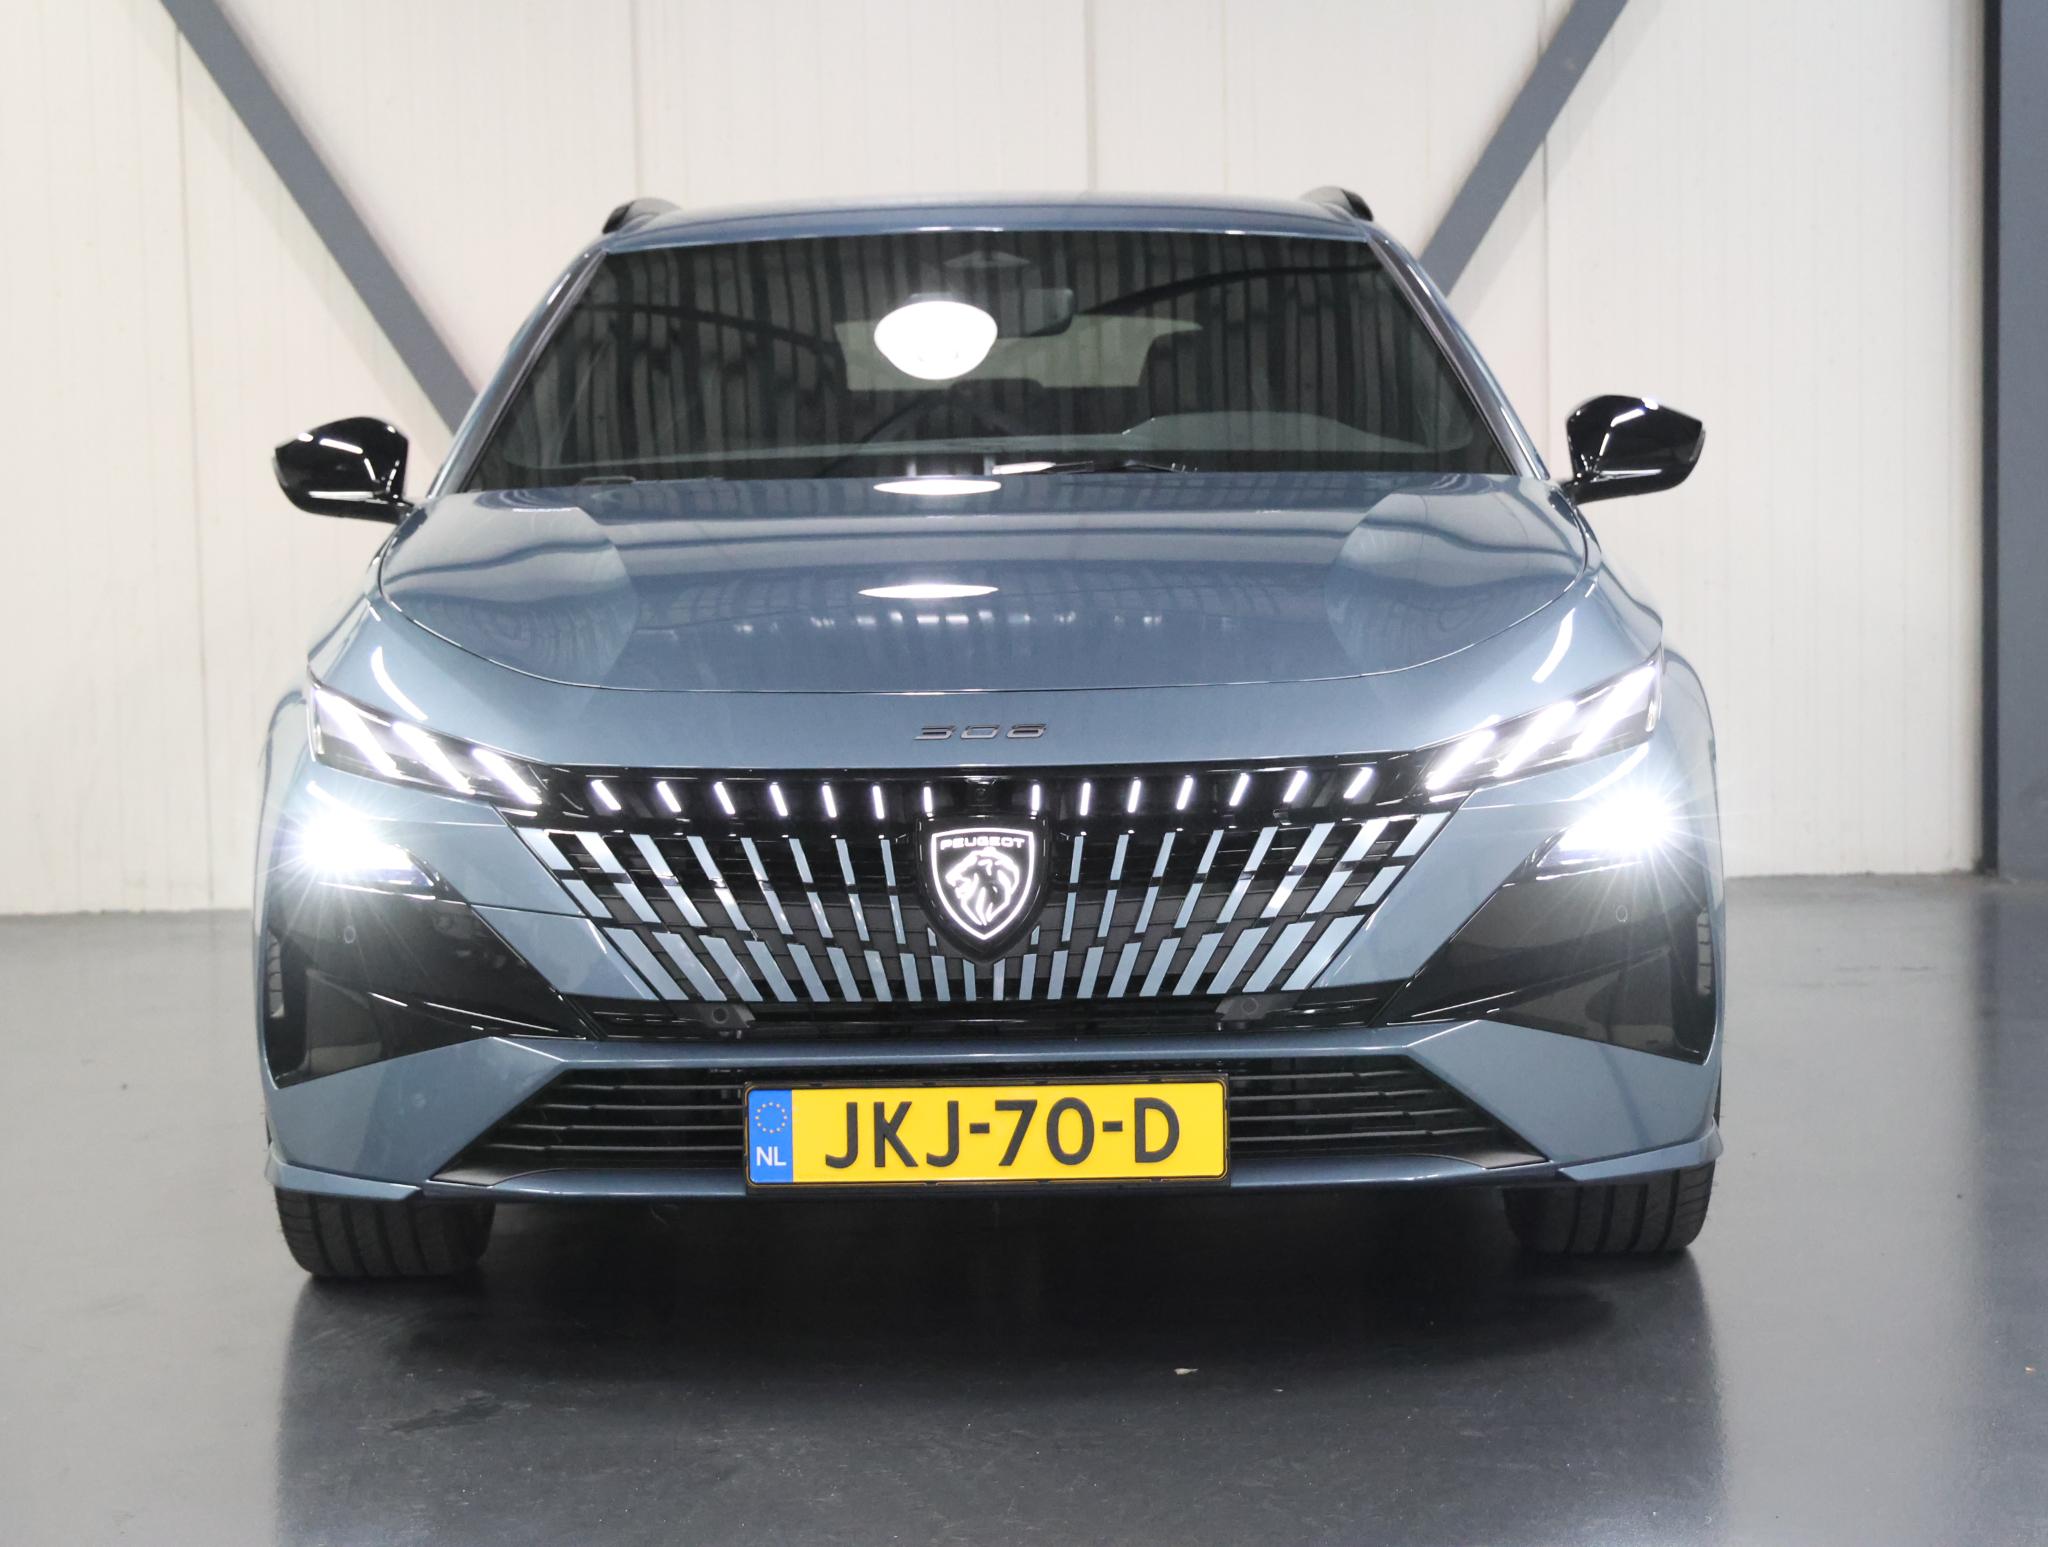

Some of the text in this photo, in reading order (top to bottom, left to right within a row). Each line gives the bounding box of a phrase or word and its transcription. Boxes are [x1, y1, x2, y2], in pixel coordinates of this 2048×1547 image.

[913, 724, 1047, 740] 308
[940, 836, 1025, 850] PEUGEOT
[825, 1097, 1180, 1169] JKJ-70-D
[756, 1146, 787, 1167] NL
